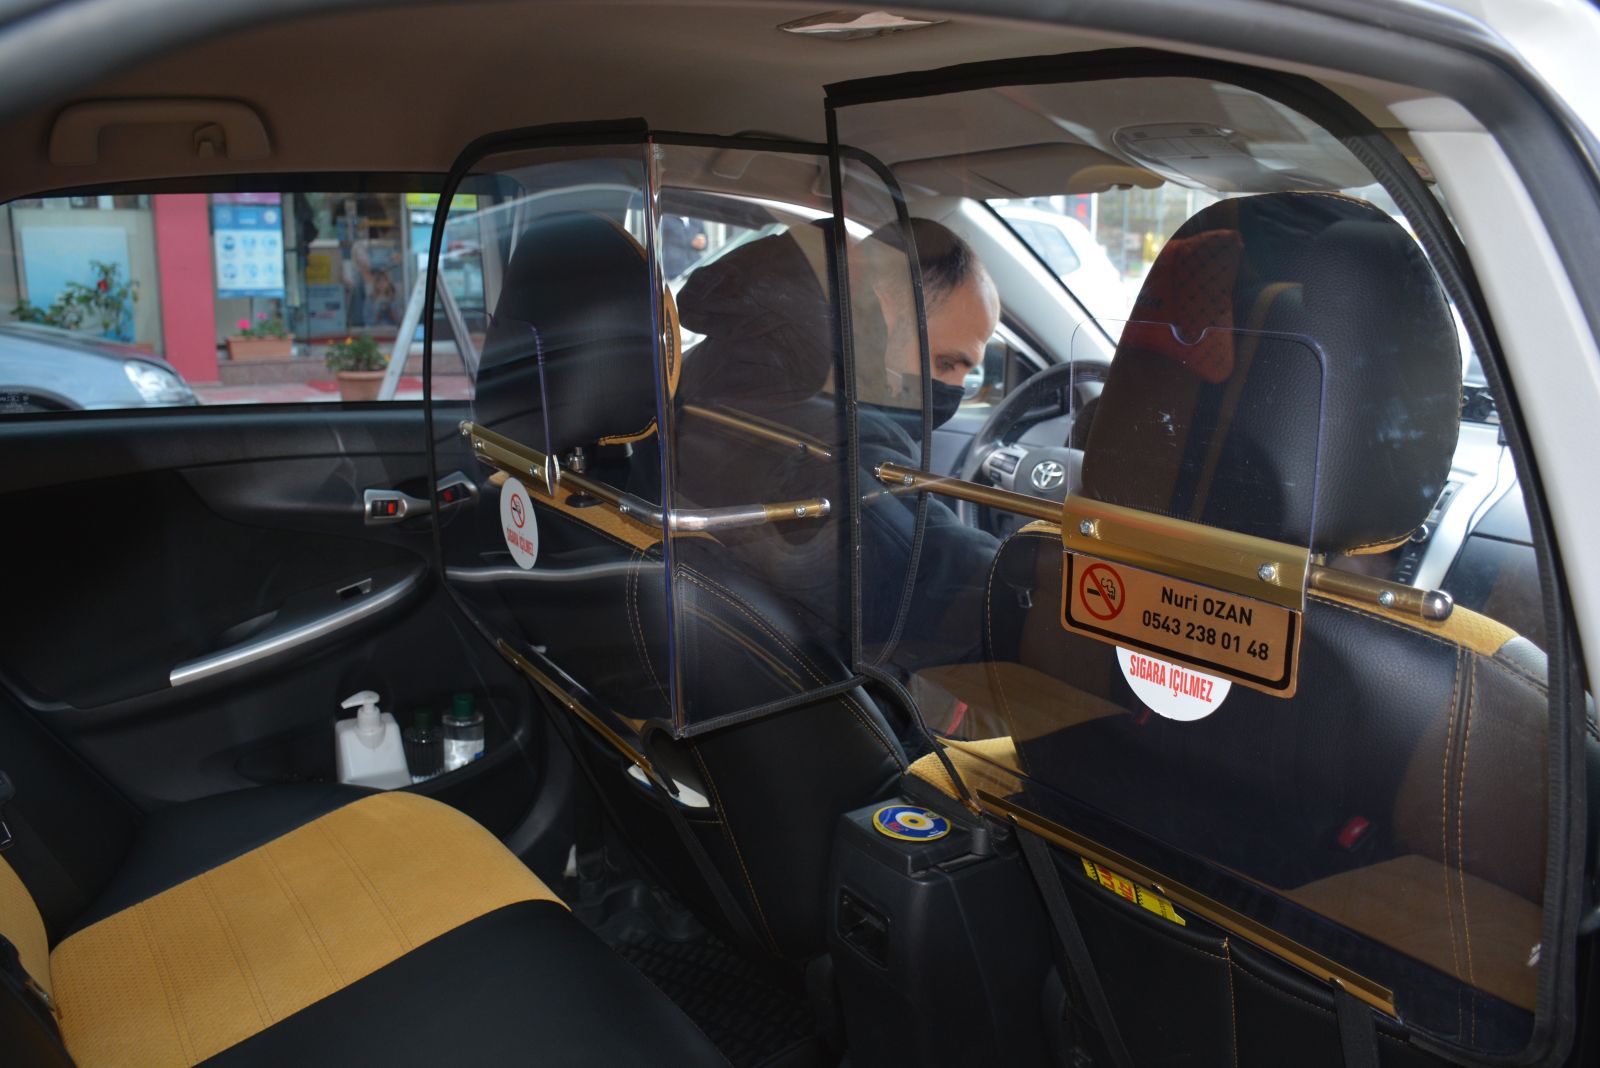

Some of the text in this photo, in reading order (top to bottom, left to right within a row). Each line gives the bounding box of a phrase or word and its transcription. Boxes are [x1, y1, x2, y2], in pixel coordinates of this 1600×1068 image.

[1161, 586, 1253, 626] Nuri OZAN
[1142, 610, 1269, 660] 0543 238 01 48
[1129, 655, 1166, 687] SIGARA
